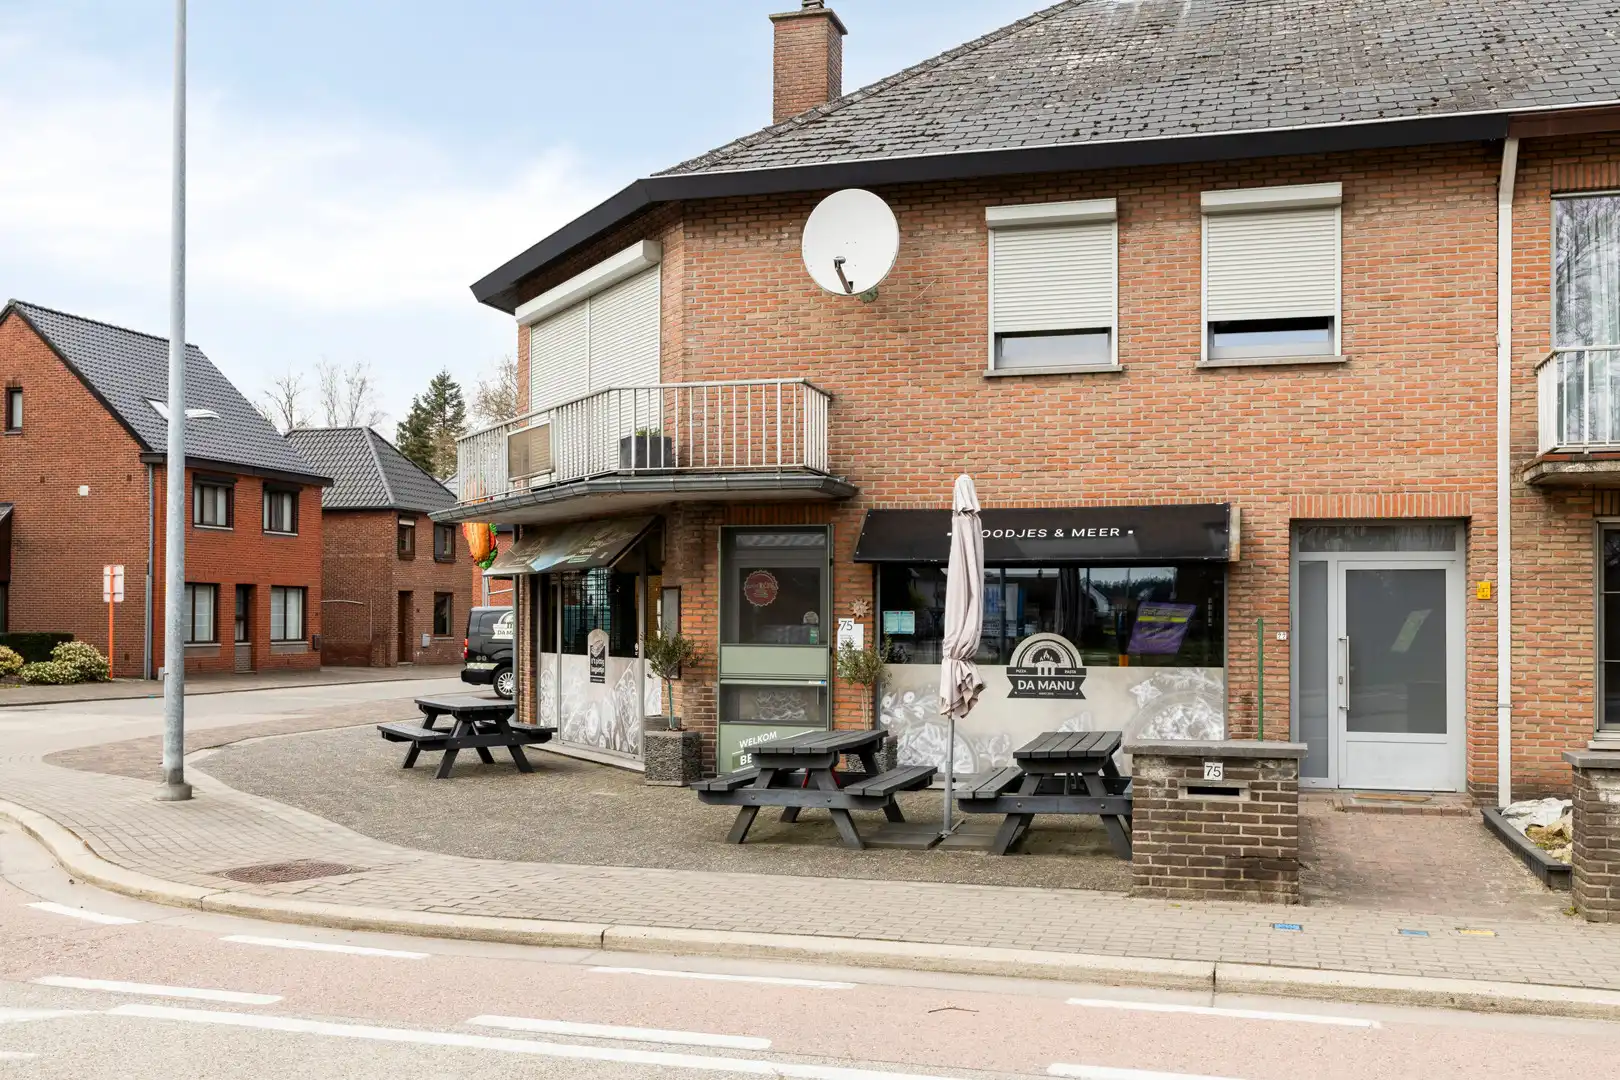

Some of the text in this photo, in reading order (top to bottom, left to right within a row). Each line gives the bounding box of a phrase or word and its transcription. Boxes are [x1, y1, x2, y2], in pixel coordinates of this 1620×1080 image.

[981, 527, 1120, 538] OODJES & MEER
[840, 620, 853, 631] 75
[1017, 680, 1075, 691] DA MANU
[739, 730, 778, 749] WELKOM
[1205, 765, 1222, 778] 75
